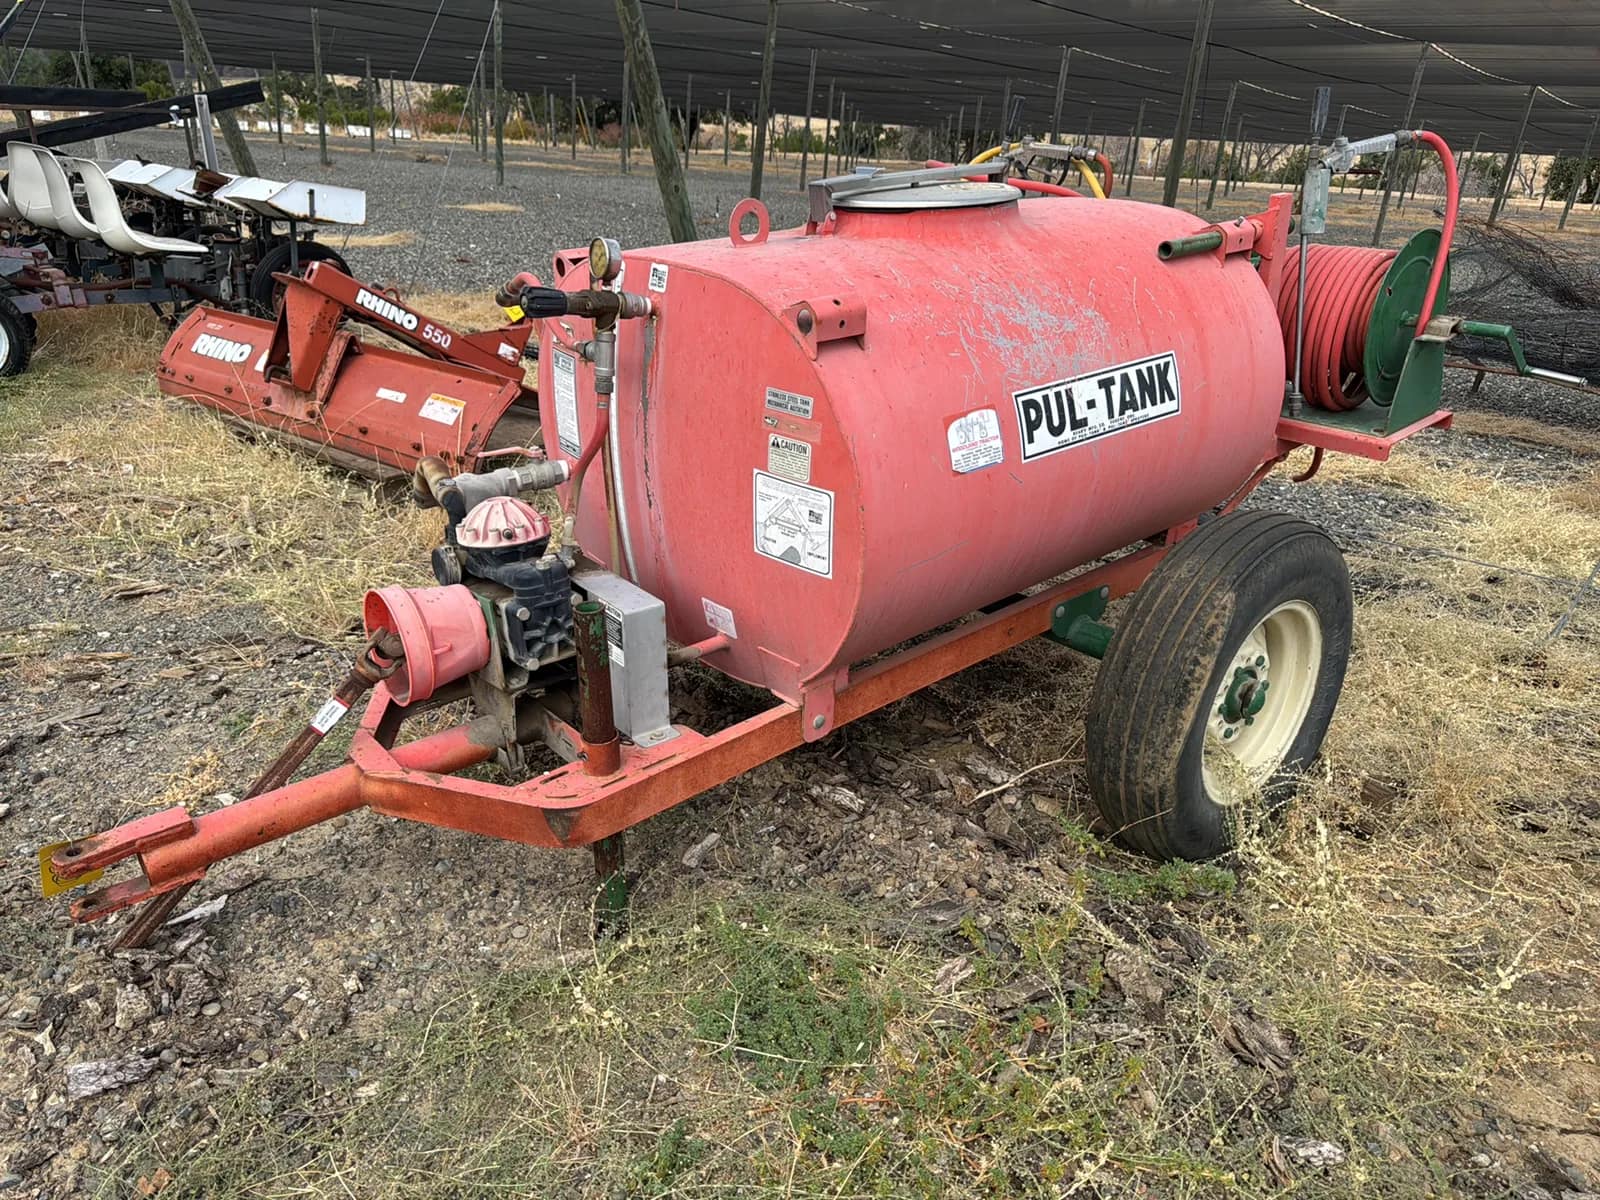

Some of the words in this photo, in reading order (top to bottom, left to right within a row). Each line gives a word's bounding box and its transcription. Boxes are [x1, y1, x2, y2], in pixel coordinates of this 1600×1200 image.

[355, 288, 418, 331] RHINO
[422, 324, 451, 348] 550
[190, 333, 252, 363] RHINO
[1021, 361, 1176, 445] PUL-TANK
[781, 439, 807, 455] CAUTION
